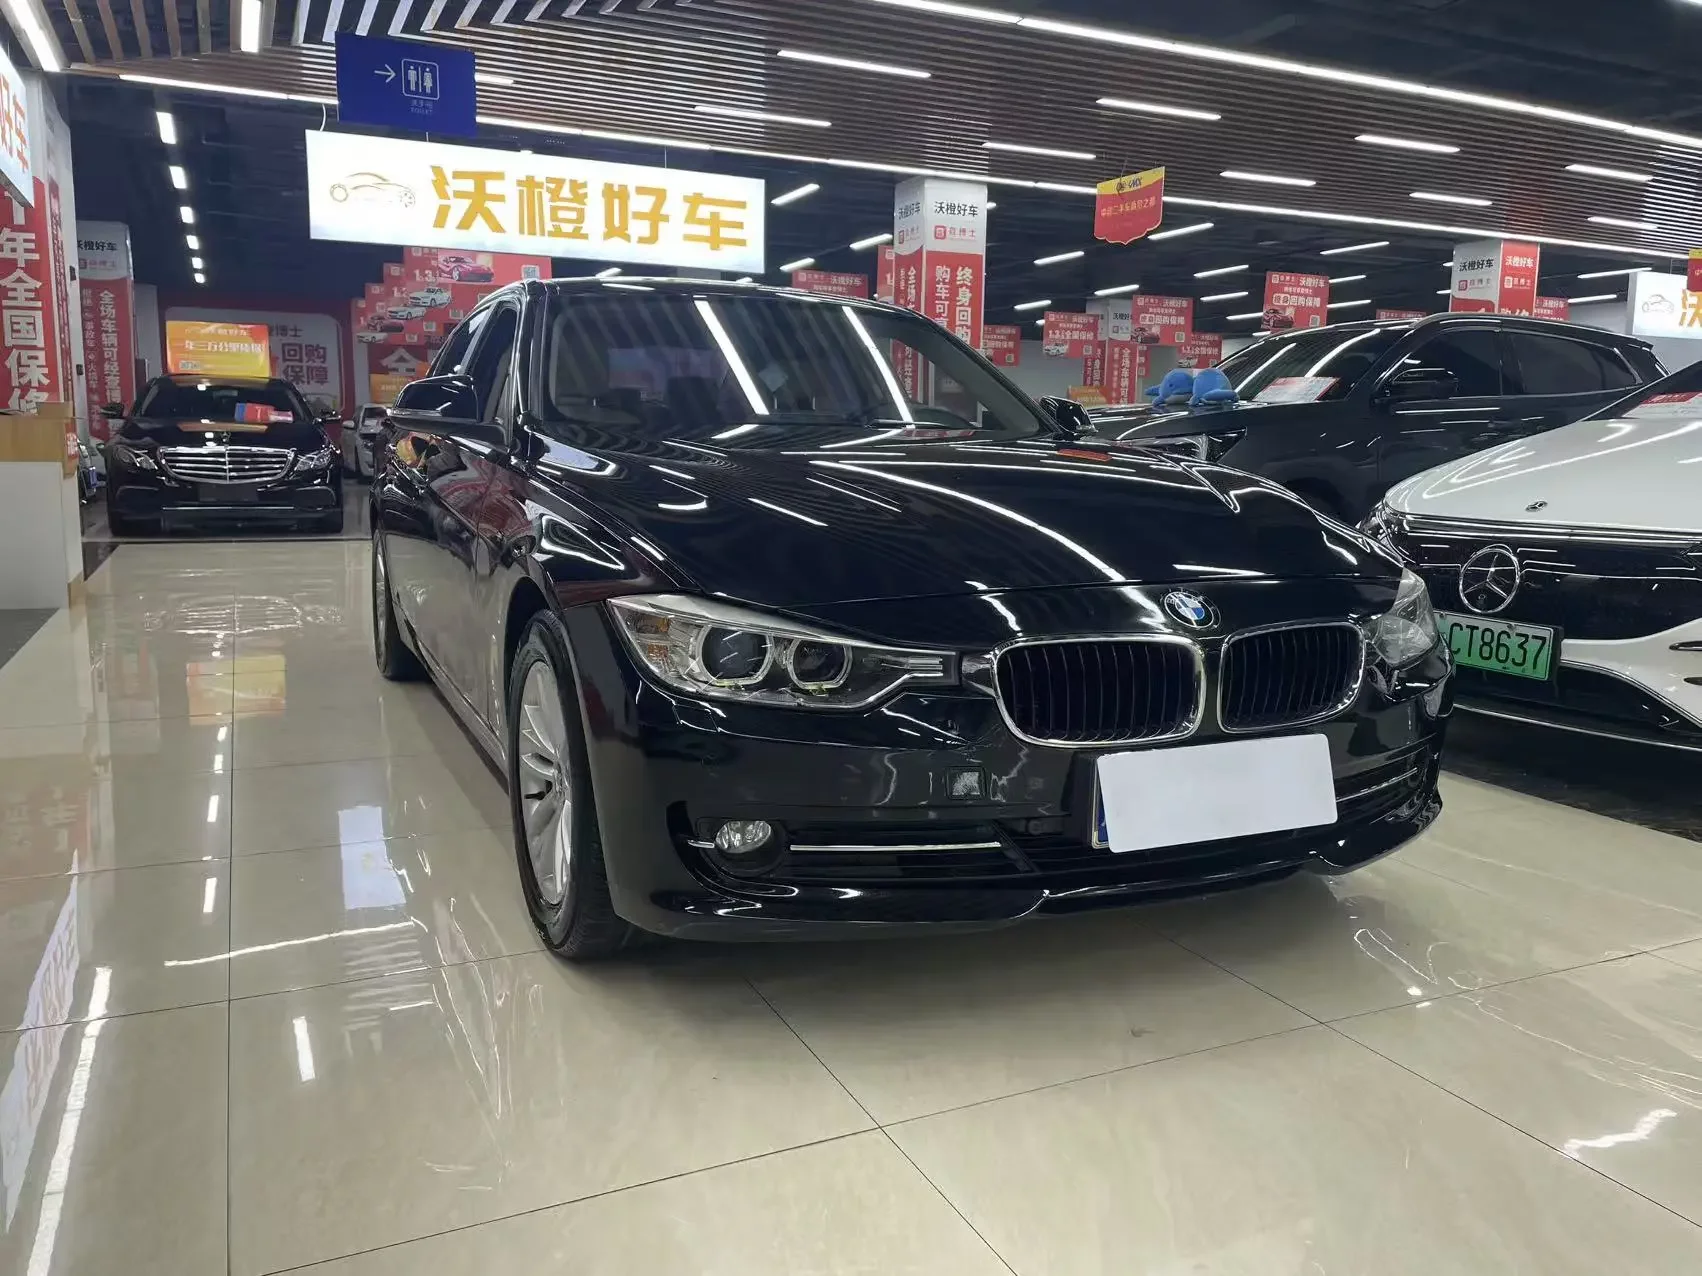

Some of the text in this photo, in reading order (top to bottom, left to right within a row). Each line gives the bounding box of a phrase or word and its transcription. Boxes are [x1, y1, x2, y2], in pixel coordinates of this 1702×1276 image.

[431, 165, 748, 251] 沃橙好车
[934, 201, 978, 217] 沃橙好车
[1459, 258, 1494, 271] 沃橙好车
[1504, 256, 1533, 268] 沃橙好车
[956, 267, 973, 344] 终身回购
[281, 344, 328, 364] 回购
[282, 365, 329, 386] 保障
[1448, 622, 1547, 670] CT8637
